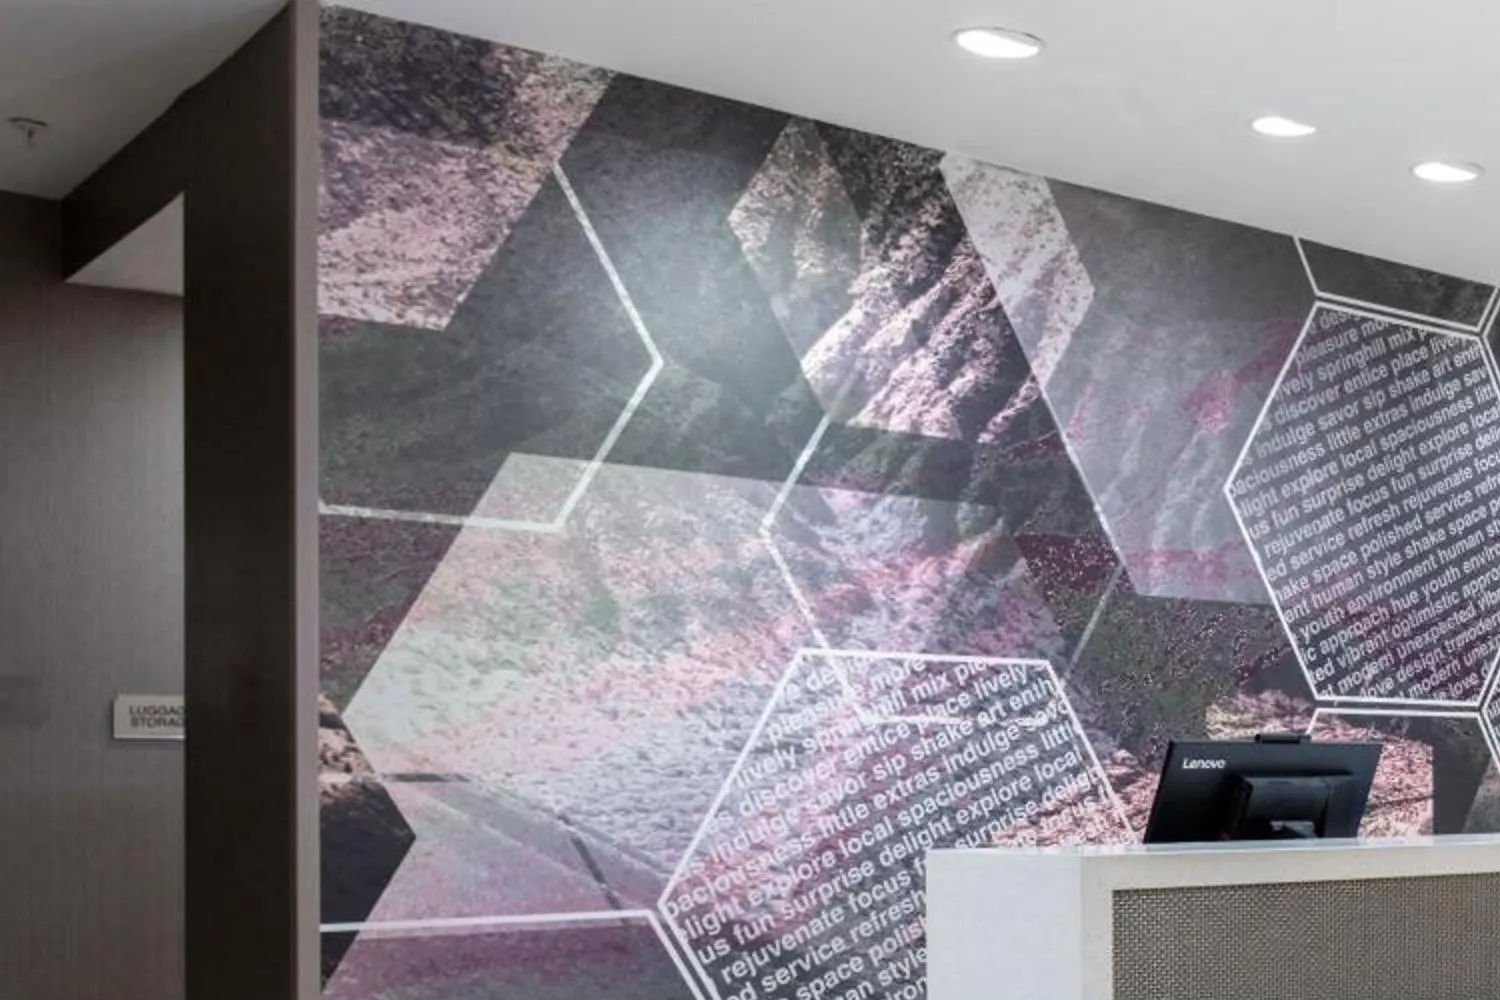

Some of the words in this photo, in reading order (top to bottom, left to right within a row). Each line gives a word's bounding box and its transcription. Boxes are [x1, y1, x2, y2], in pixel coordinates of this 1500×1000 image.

[1274, 384, 1342, 425] discover
[1344, 364, 1388, 394] entice
[1391, 345, 1429, 375] place
[1295, 327, 1359, 374] pleasure
[1318, 338, 1387, 382] springhill
[1255, 421, 1316, 458] indulge
[1318, 401, 1360, 431] savor
[1363, 389, 1387, 410] sip
[1389, 369, 1432, 399] shake
[1432, 358, 1453, 379] art
[1281, 460, 1340, 499] explore
[1341, 439, 1378, 470] local
[1380, 395, 1475, 453] spaciousness
[1326, 424, 1361, 451] little
[1363, 403, 1409, 434] extras
[1408, 378, 1462, 412] indulge
[1264, 507, 1346, 560] rejuvenate
[1345, 484, 1391, 517] focus
[1390, 472, 1418, 495] fun
[1418, 442, 1474, 481] surprise
[1271, 504, 1300, 527] fun
[1301, 473, 1365, 513] surprise
[1366, 446, 1417, 481] delight
[1419, 421, 1470, 456] explore
[1290, 534, 1346, 570] service
[1347, 502, 1401, 541] refresh
[1402, 466, 1474, 513] rejuvenate
[1311, 549, 1360, 584] space
[1360, 514, 1424, 565] polished
[1425, 489, 1474, 525] service
[1312, 571, 1365, 609] human
[1366, 551, 1402, 579] style
[1405, 528, 1447, 560] shake
[1447, 504, 1488, 536] space
[1300, 607, 1346, 645] youth
[1347, 552, 1439, 614] environment
[1439, 530, 1485, 566] human
[1319, 606, 1391, 655] approach
[1389, 590, 1419, 615] hue
[1421, 566, 1462, 602] youth
[1336, 630, 1388, 669] vibrant
[1391, 589, 1461, 639] optimistic
[1337, 650, 1395, 697] modern
[1395, 603, 1478, 660] unexpected
[1396, 647, 1445, 683] design
[1408, 660, 1462, 698] modern
[1448, 671, 1479, 698] love
[129, 704, 184, 716] LUGGAG
[130, 717, 184, 728] STORAG
[738, 745, 797, 790] lively
[911, 671, 949, 703] mix
[741, 756, 838, 818] discover
[844, 718, 911, 763] entice
[914, 690, 971, 736] place
[974, 662, 1029, 700] lively
[708, 804, 799, 861] indulge
[799, 771, 868, 818] savor
[872, 754, 907, 781] sip
[911, 718, 974, 762] shake
[977, 696, 1007, 725] art
[821, 798, 870, 838] little
[873, 764, 940, 810] extras
[943, 722, 1020, 774] indulge
[1182, 758, 1226, 769] Lenovo
[733, 912, 775, 945] fun
[781, 860, 875, 920] surprise
[879, 815, 954, 867] delight
[955, 771, 1033, 823] explore
[1034, 744, 1083, 781] local
[749, 848, 837, 906] explore
[838, 816, 895, 857] local
[897, 743, 1039, 828] spaciousness
[720, 906, 845, 983] rejuvenate
[848, 866, 912, 915] focus
[955, 799, 1038, 849] surprise
[761, 936, 845, 993] service
[878, 947, 927, 987] style
